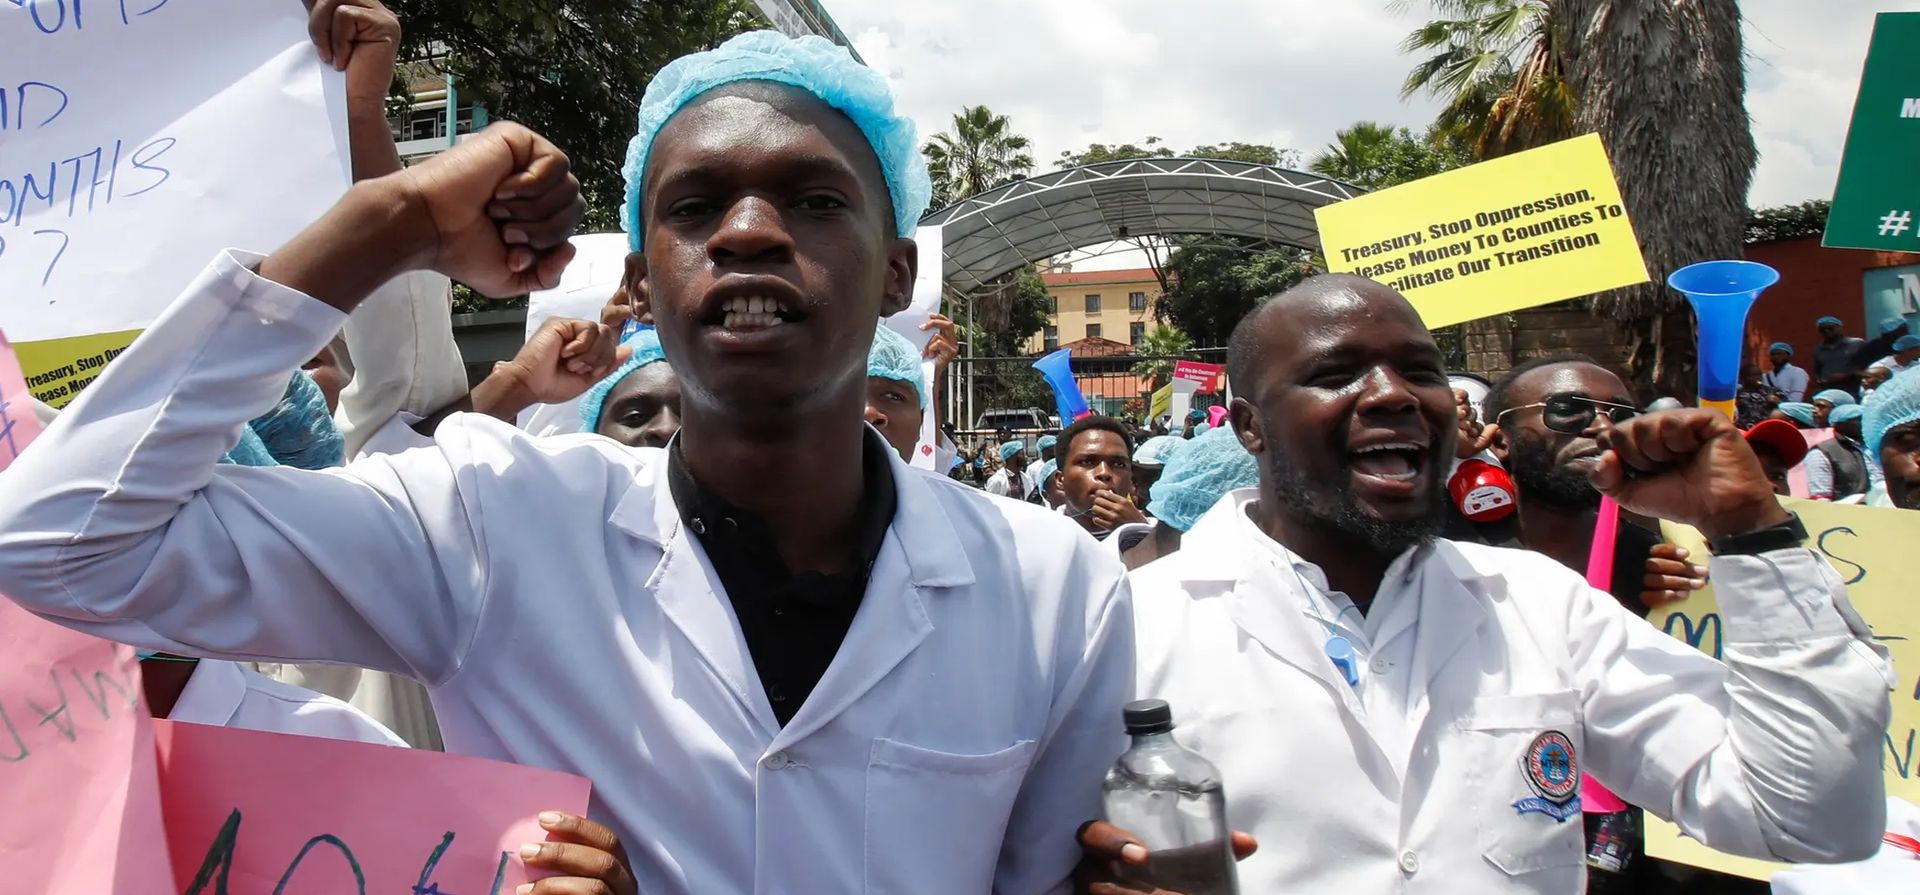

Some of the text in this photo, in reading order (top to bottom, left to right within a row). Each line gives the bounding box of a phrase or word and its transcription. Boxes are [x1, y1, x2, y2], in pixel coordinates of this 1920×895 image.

[1341, 188, 1595, 263] Treasury, Stop Oppression,
[1408, 240, 1472, 267] Money
[1474, 233, 1499, 250] To
[1502, 211, 1593, 243] Counties
[1595, 203, 1622, 220] To
[1387, 231, 1600, 292] cilitate Our Transition
[32, 384, 69, 403] lease
[76, 354, 105, 372] Stop
